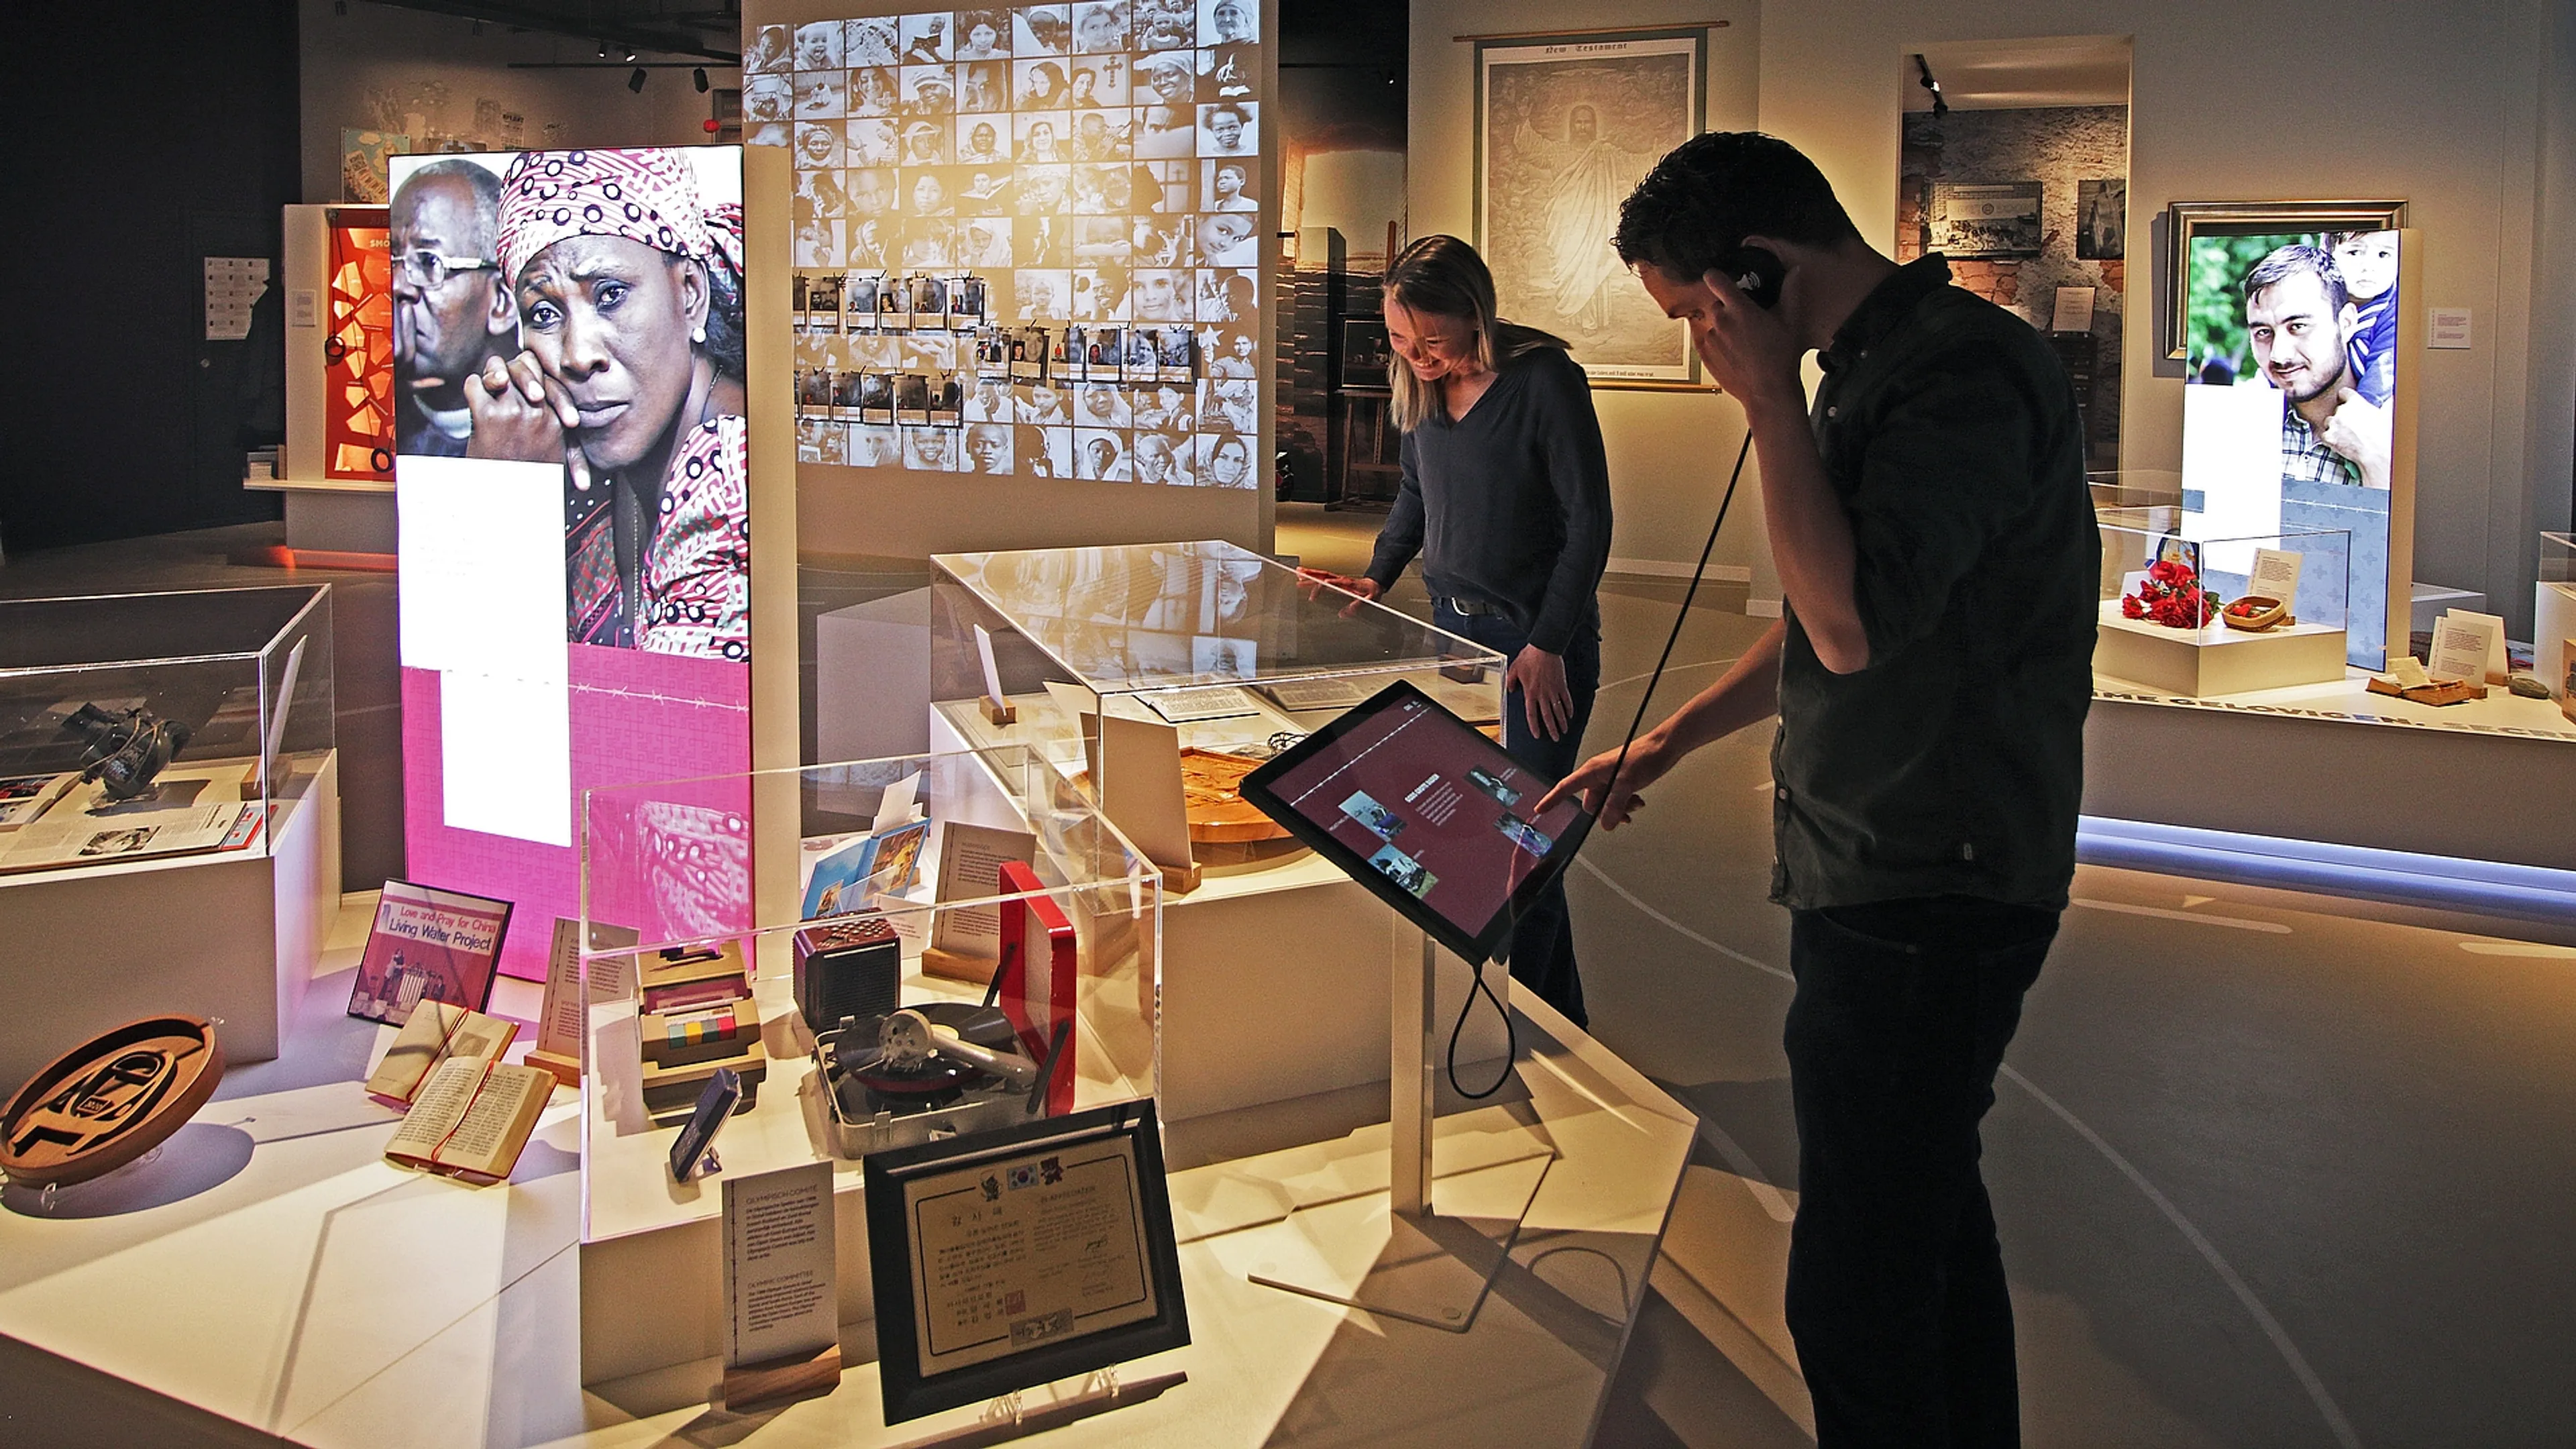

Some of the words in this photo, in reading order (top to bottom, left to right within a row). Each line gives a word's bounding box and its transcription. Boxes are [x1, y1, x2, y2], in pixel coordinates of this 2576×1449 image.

[1575, 43, 1627, 52] Testament
[400, 906, 417, 918] Love
[420, 911, 435, 922] and
[436, 913, 455, 928] Pray
[458, 916, 469, 928] for
[472, 919, 497, 934] China
[389, 918, 418, 938] Living
[422, 923, 451, 941] Water
[452, 931, 492, 951] Project
